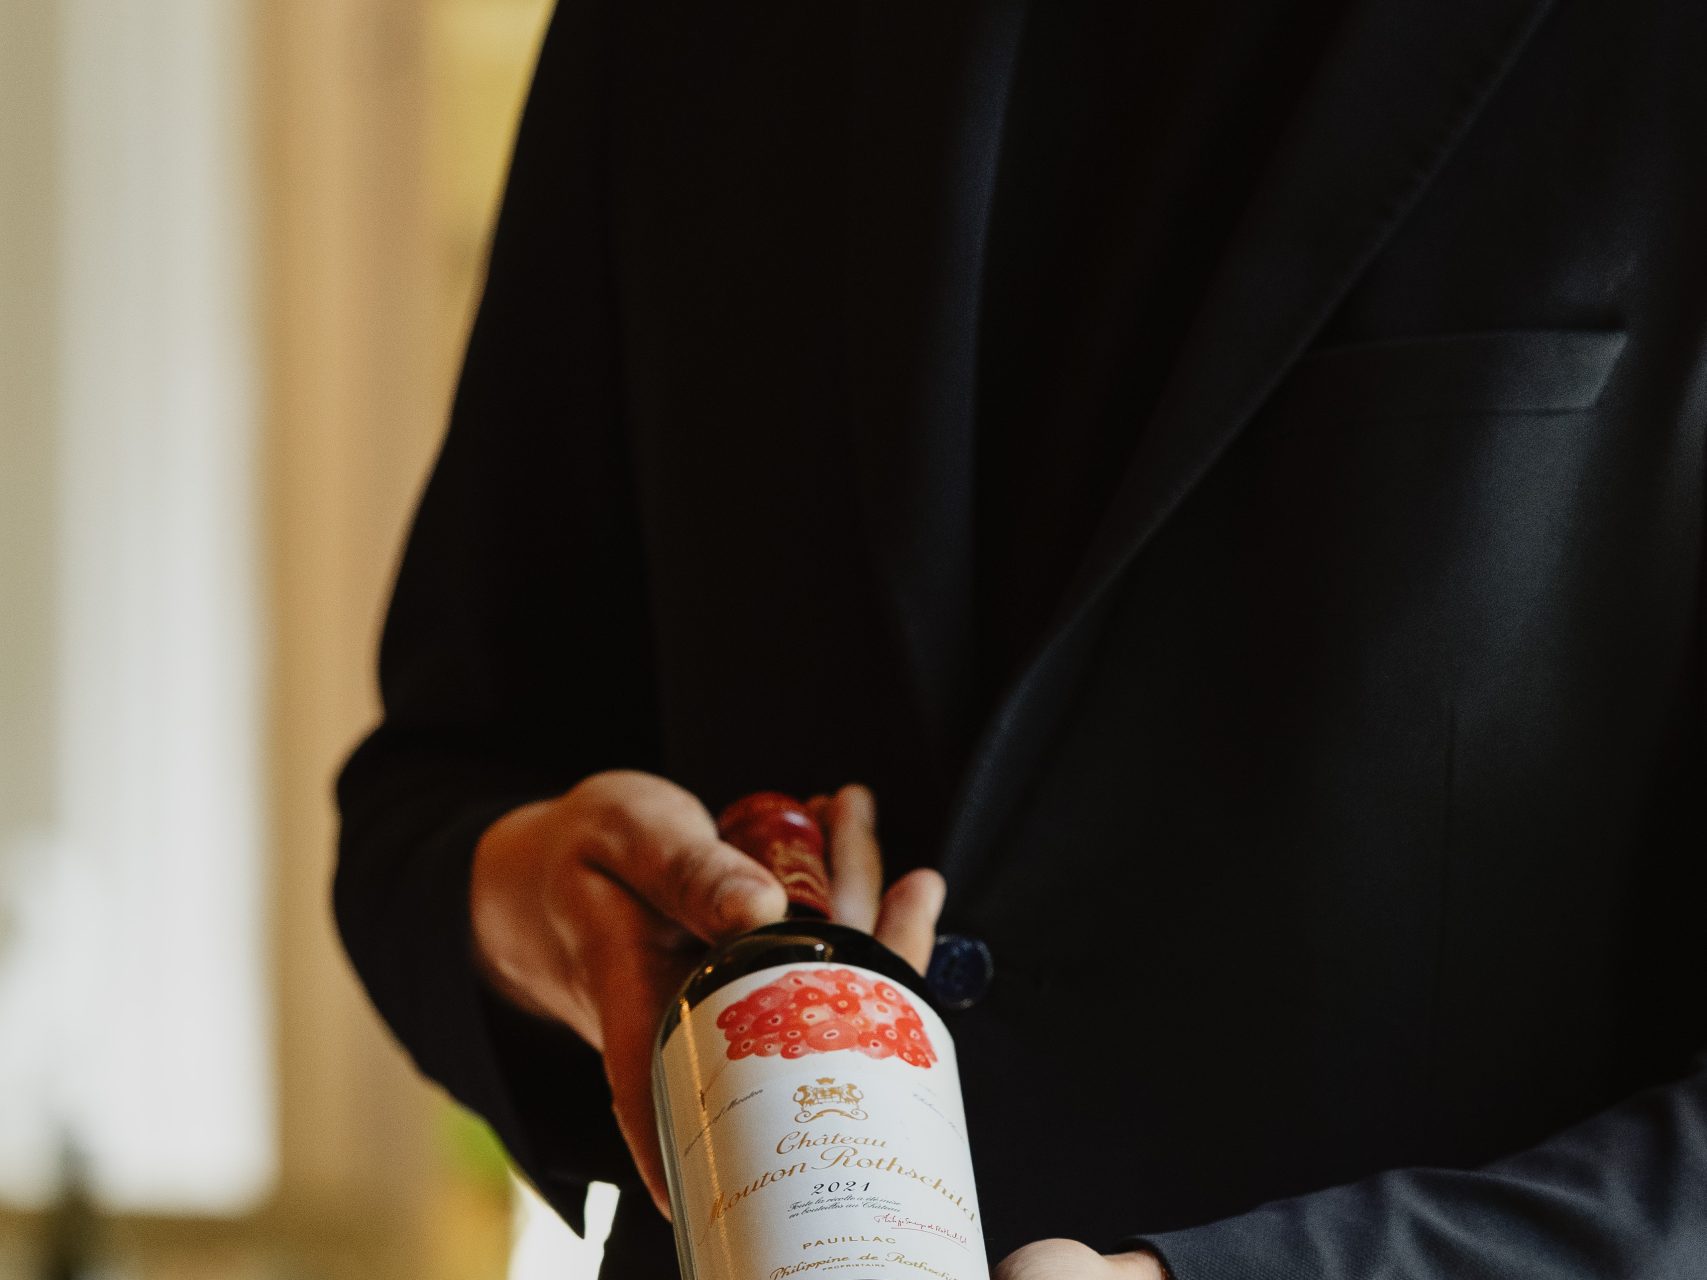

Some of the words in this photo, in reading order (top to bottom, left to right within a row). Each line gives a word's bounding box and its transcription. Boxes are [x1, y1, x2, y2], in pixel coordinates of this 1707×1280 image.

[776, 1131, 887, 1155] Château
[811, 1146, 976, 1223] Rothschild
[811, 1181, 870, 1195] 2021
[803, 1236, 896, 1250] PAUILLAC
[857, 1253, 879, 1261] de
